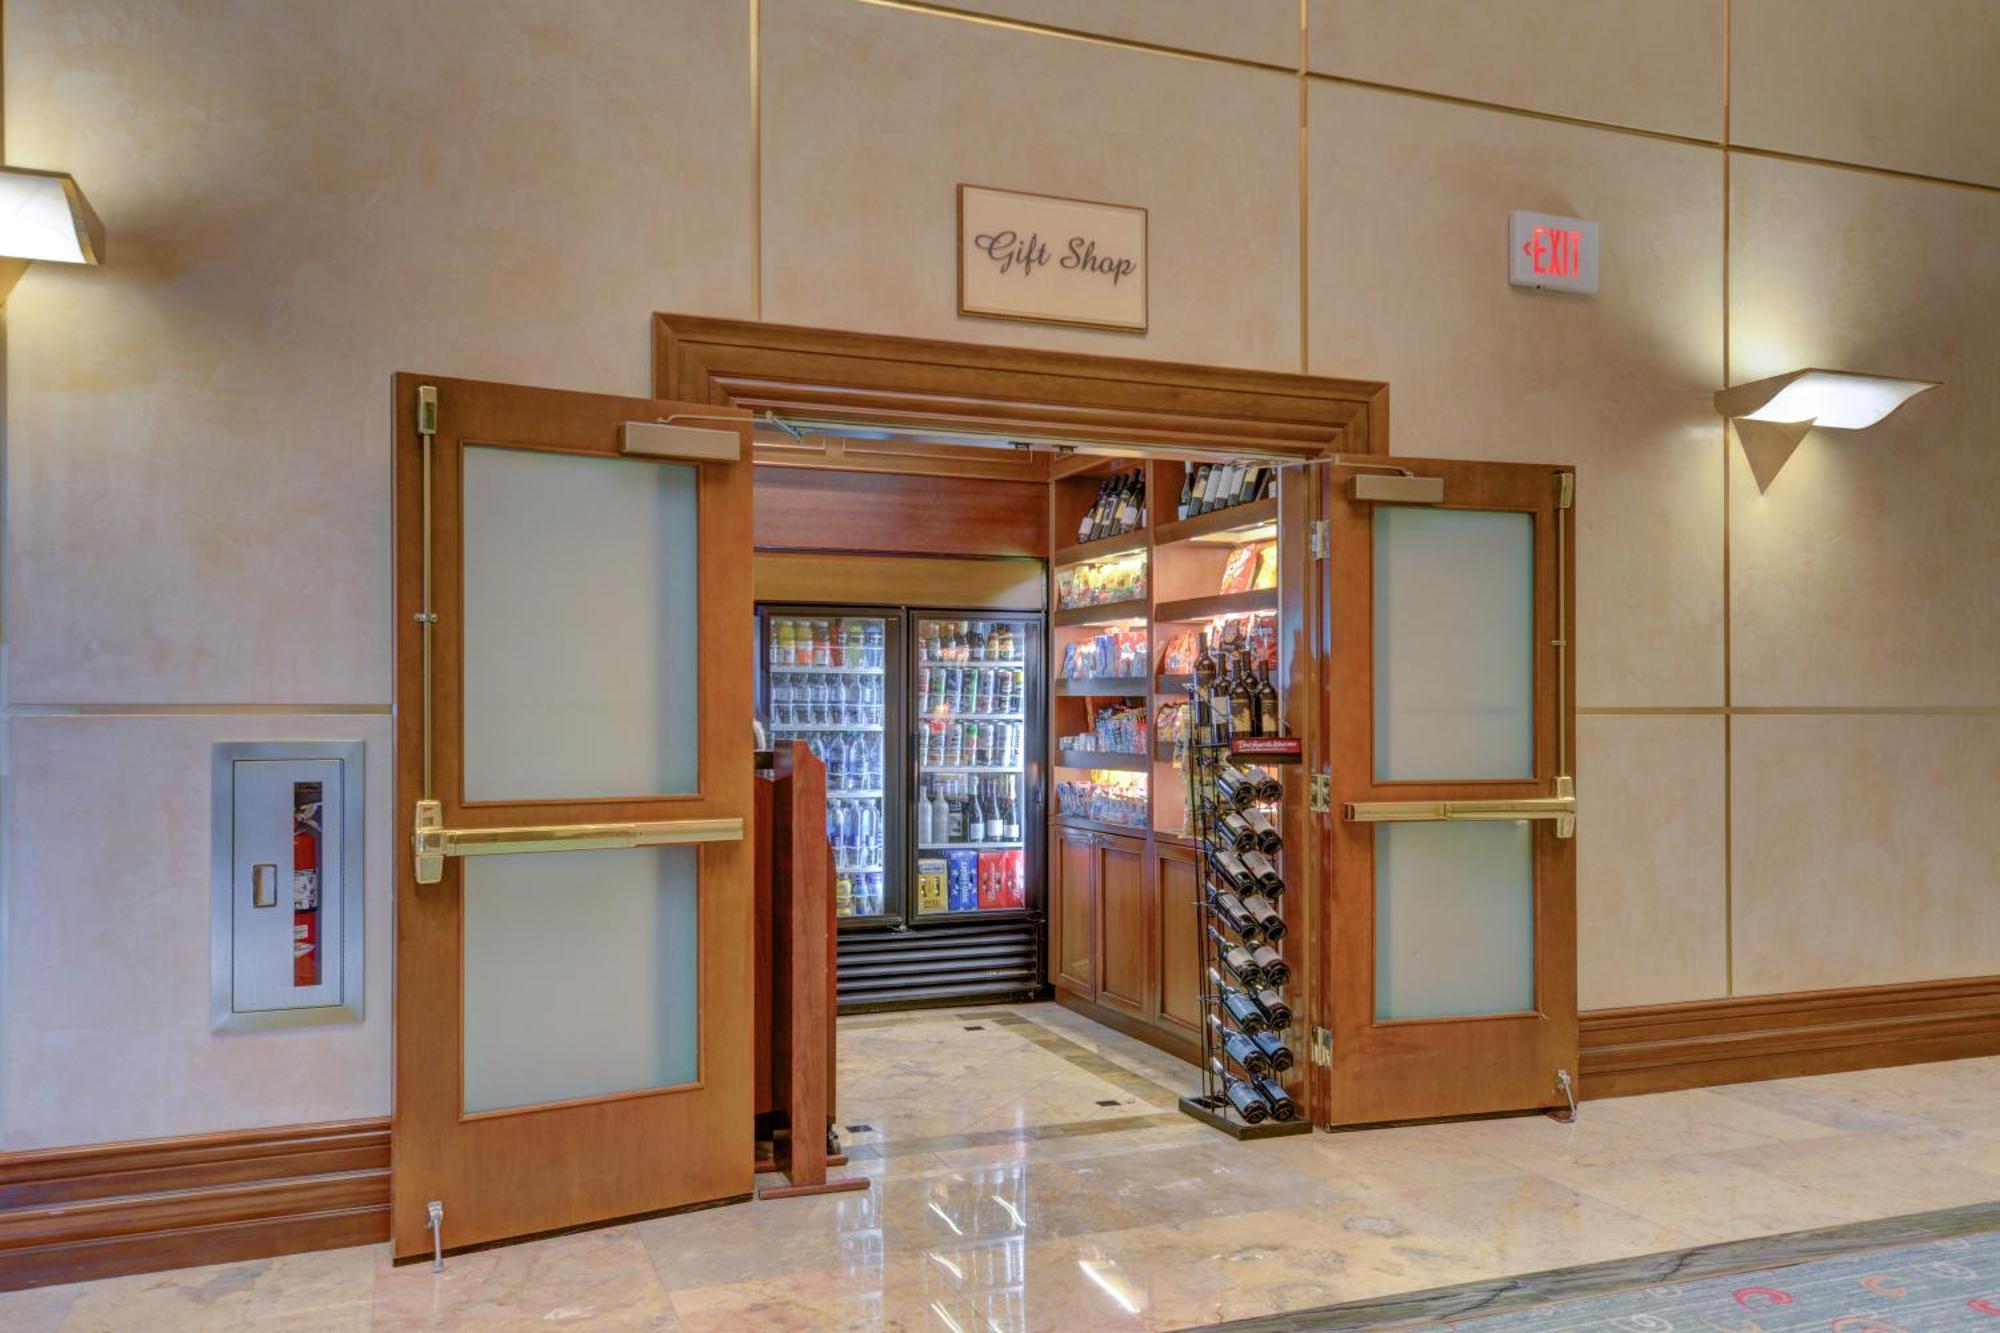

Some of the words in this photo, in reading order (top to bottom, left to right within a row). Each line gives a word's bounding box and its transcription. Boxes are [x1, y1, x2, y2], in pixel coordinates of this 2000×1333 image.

[974, 230, 1051, 277] Gift
[1059, 236, 1137, 286] Shop
[1533, 226, 1584, 280] EXIT
